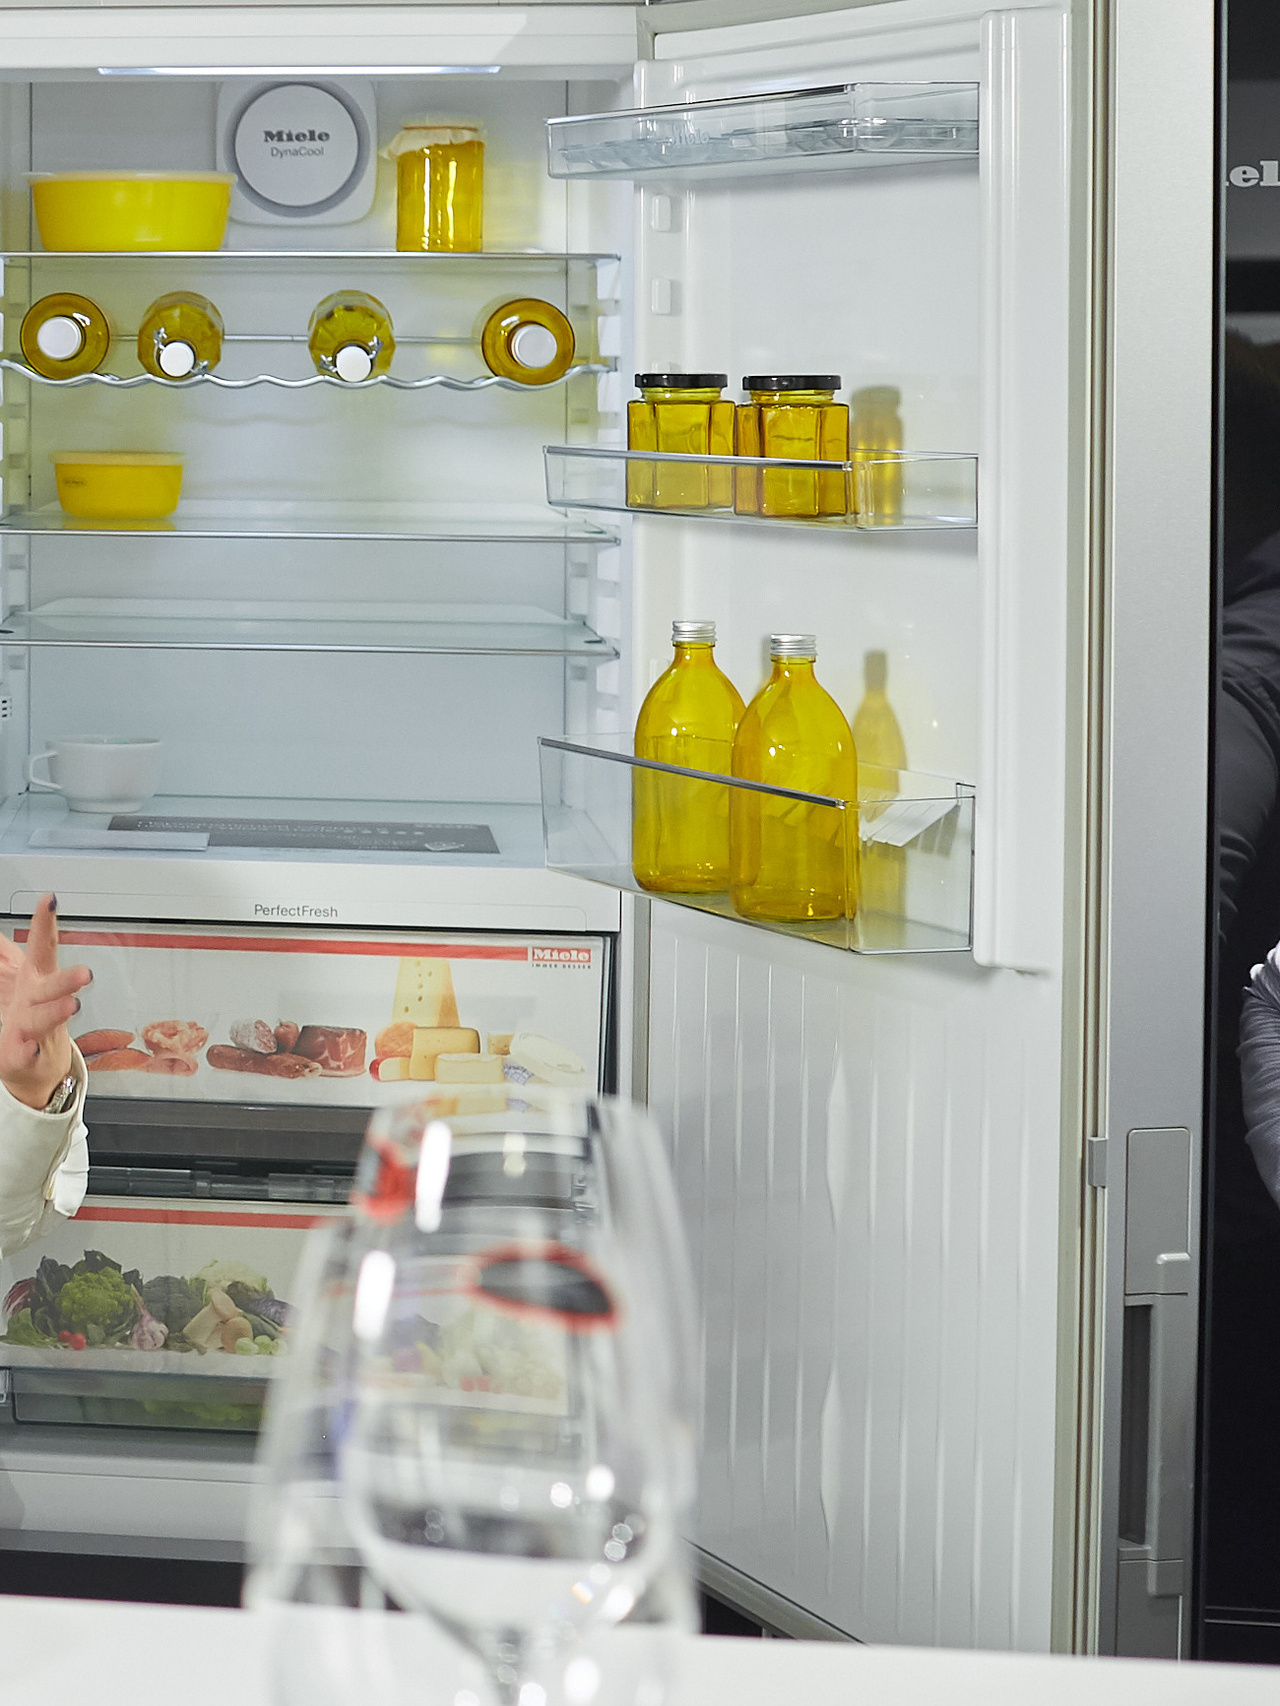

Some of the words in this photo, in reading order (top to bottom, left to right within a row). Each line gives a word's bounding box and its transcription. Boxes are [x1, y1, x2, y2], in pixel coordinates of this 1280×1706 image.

[263, 129, 330, 143] Miele
[270, 146, 325, 159] DynaCool
[1226, 160, 1280, 187] el
[254, 903, 338, 918] PerfectFresh
[533, 948, 590, 961] Miele
